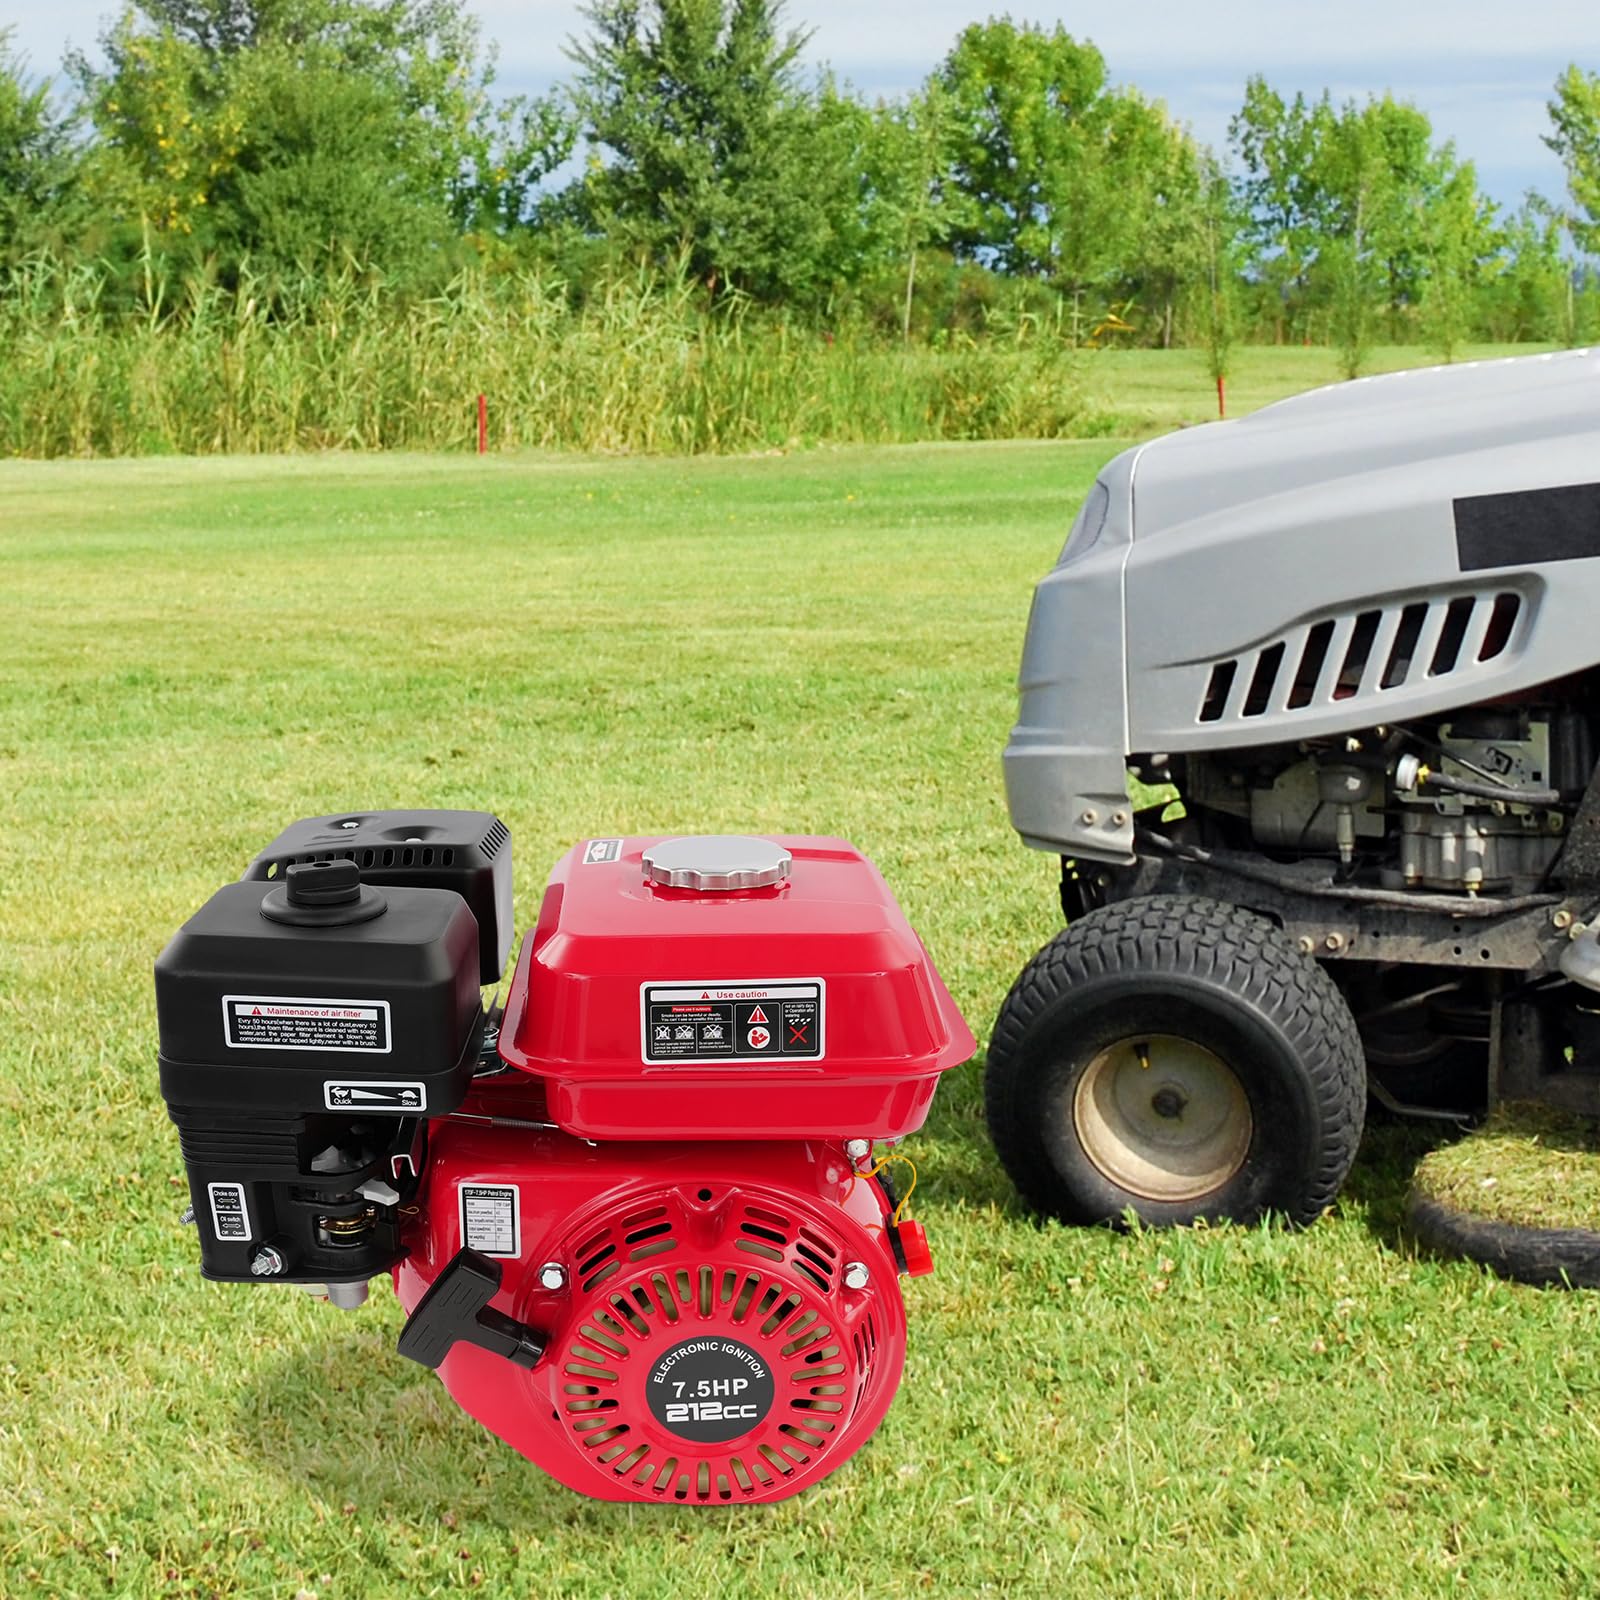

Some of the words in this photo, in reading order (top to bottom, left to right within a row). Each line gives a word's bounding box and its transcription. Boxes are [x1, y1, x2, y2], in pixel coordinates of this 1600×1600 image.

[267, 1008, 320, 1017] Maintenance
[654, 1342, 719, 1383] ELECTRONIC
[722, 1344, 765, 1378] IGNITION
[672, 1378, 749, 1398] 7.5HP
